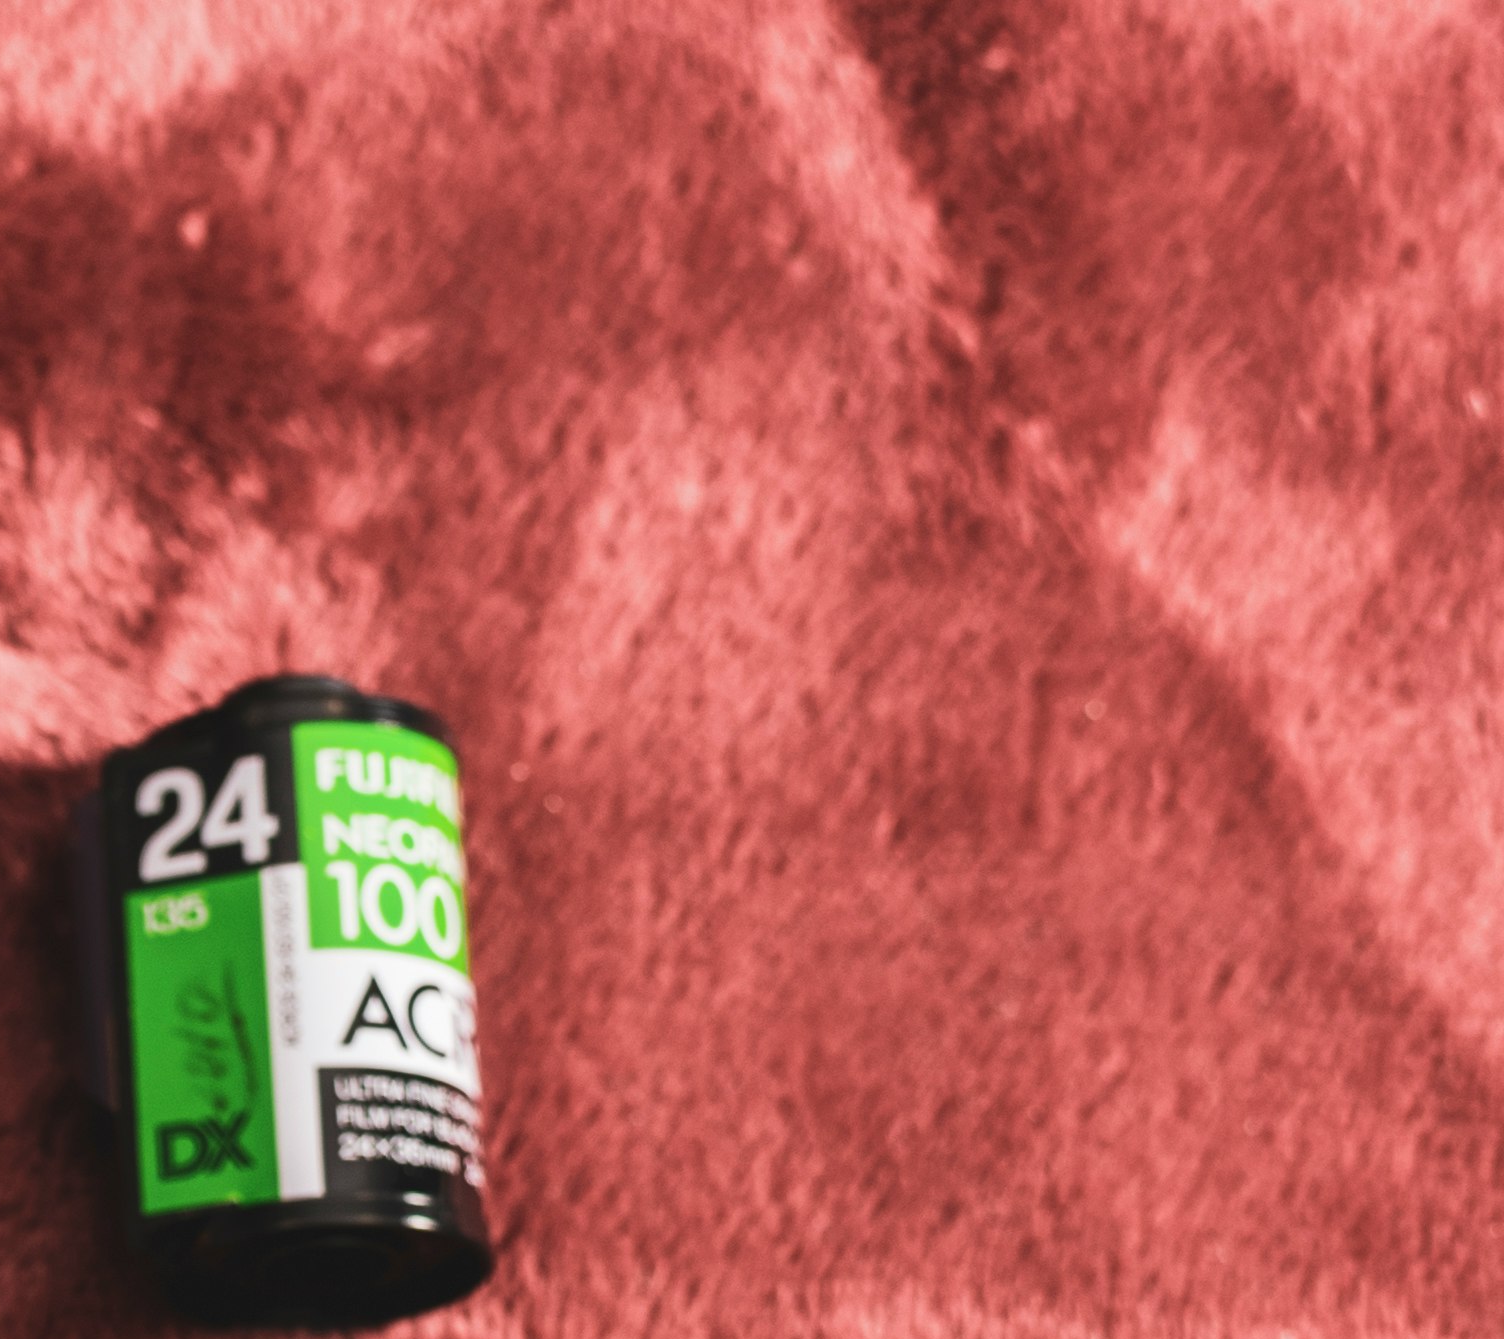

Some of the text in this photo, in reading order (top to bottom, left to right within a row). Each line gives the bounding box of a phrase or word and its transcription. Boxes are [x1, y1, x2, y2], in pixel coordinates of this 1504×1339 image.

[134, 753, 281, 883] 24
[325, 860, 462, 961] 100
[153, 1108, 256, 1184] DX
